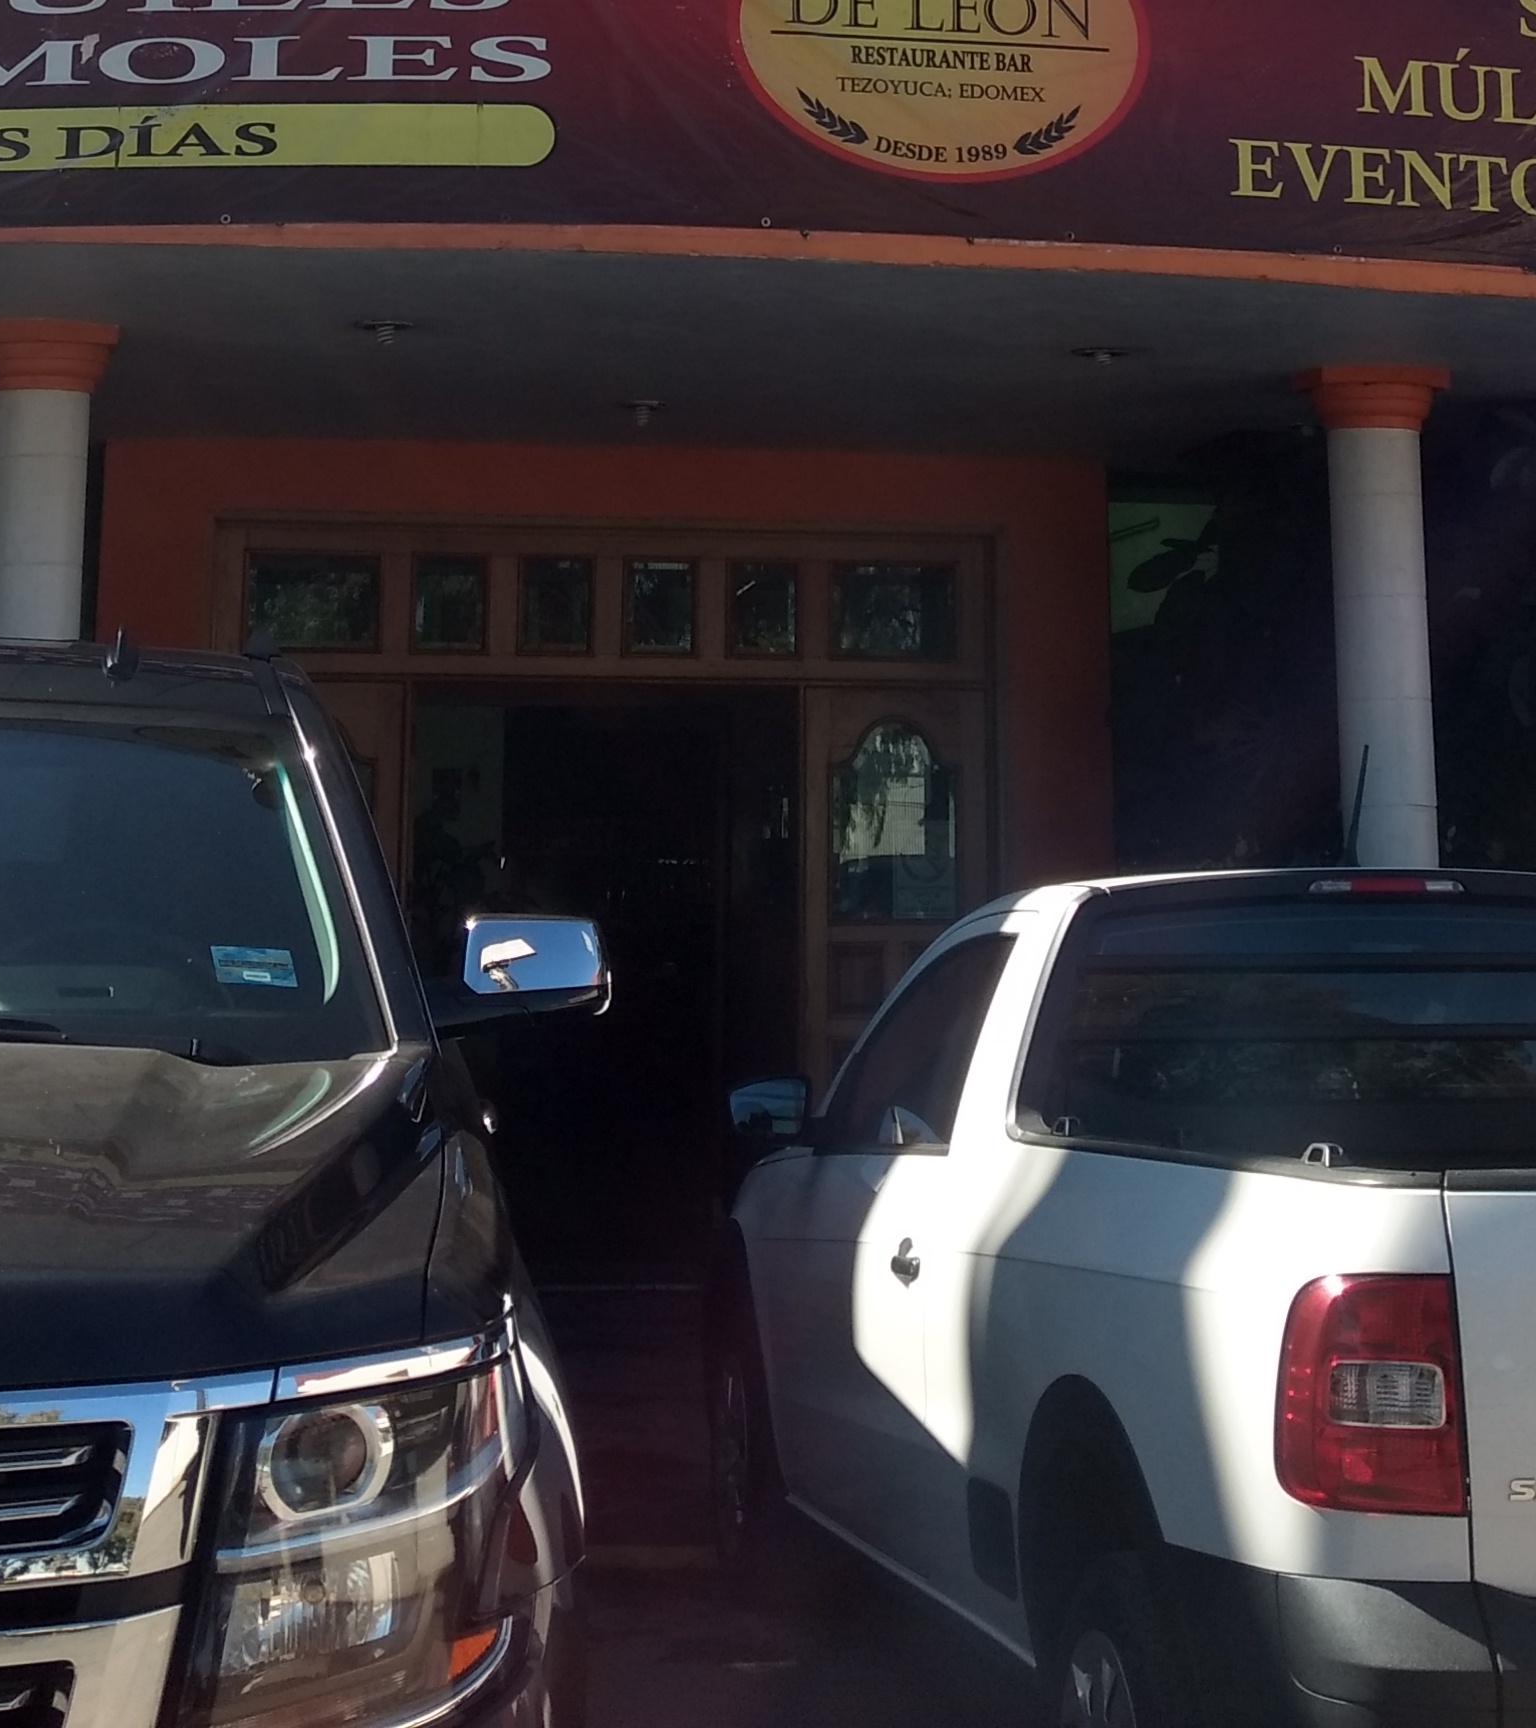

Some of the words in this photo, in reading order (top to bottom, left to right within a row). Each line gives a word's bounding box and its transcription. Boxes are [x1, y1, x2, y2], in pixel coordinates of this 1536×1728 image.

[850, 44, 991, 72] RESTAURANTE
[995, 52, 1034, 73] BAR
[958, 82, 1047, 104] EDOMEX
[54, 114, 279, 162] DÍAS
[873, 135, 948, 164] DESDE
[954, 143, 1008, 164] 1989
